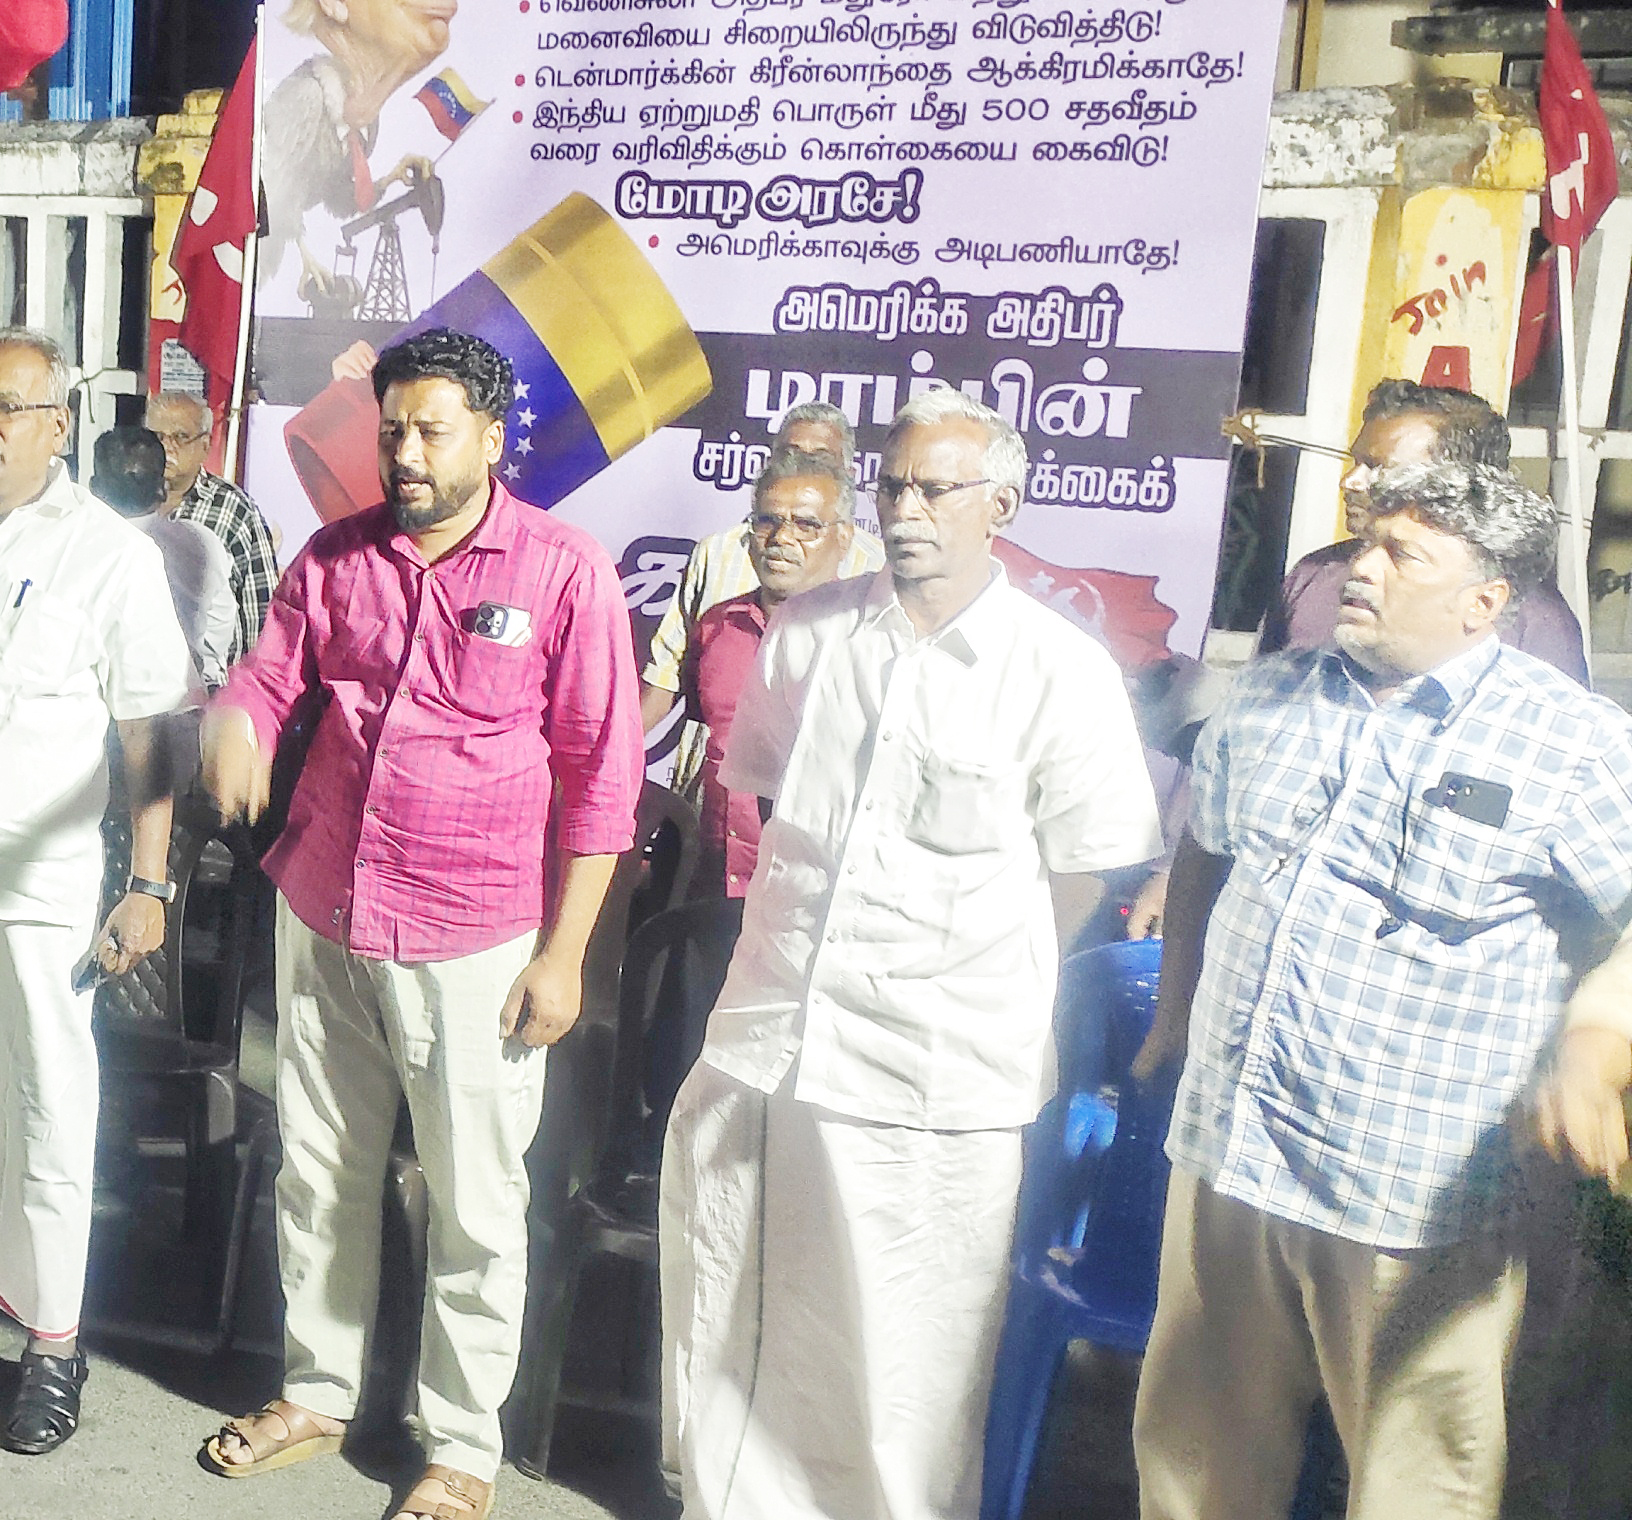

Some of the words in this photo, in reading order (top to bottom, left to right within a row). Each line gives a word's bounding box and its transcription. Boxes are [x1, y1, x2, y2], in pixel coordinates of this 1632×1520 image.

[537, 21, 711, 51] மனைவியை
[723, 17, 958, 51] சிறையிலிருந்து
[972, 8, 1162, 48] விடுவித்திடு!
[535, 57, 737, 91] டென்மார்க்கின்
[749, 54, 952, 93] கிரீன்லாந்தை
[966, 49, 1244, 88] ஆக்கிரமிக்காதே!
[532, 97, 626, 134] இந்திய
[638, 95, 761, 132] ஏற்றுமதி
[772, 94, 898, 130] பொருள்
[910, 88, 967, 130] மீது
[982, 97, 1050, 121] 500
[1064, 88, 1198, 130] சதவீதம்
[530, 142, 602, 166] வரை
[612, 129, 787, 171] வரிவிதிக்கும்
[800, 134, 1018, 162] கொள்கையை
[1032, 133, 1169, 168] கைவிடு!
[617, 172, 749, 227] மோடி
[758, 169, 922, 226] அரசே!
[676, 229, 920, 266] அமெரிக்காவுக்கு
[934, 235, 1180, 275] அடிபணியாதே!
[776, 279, 969, 341] அமெரிக்க
[985, 284, 1119, 349] அதிபர்
